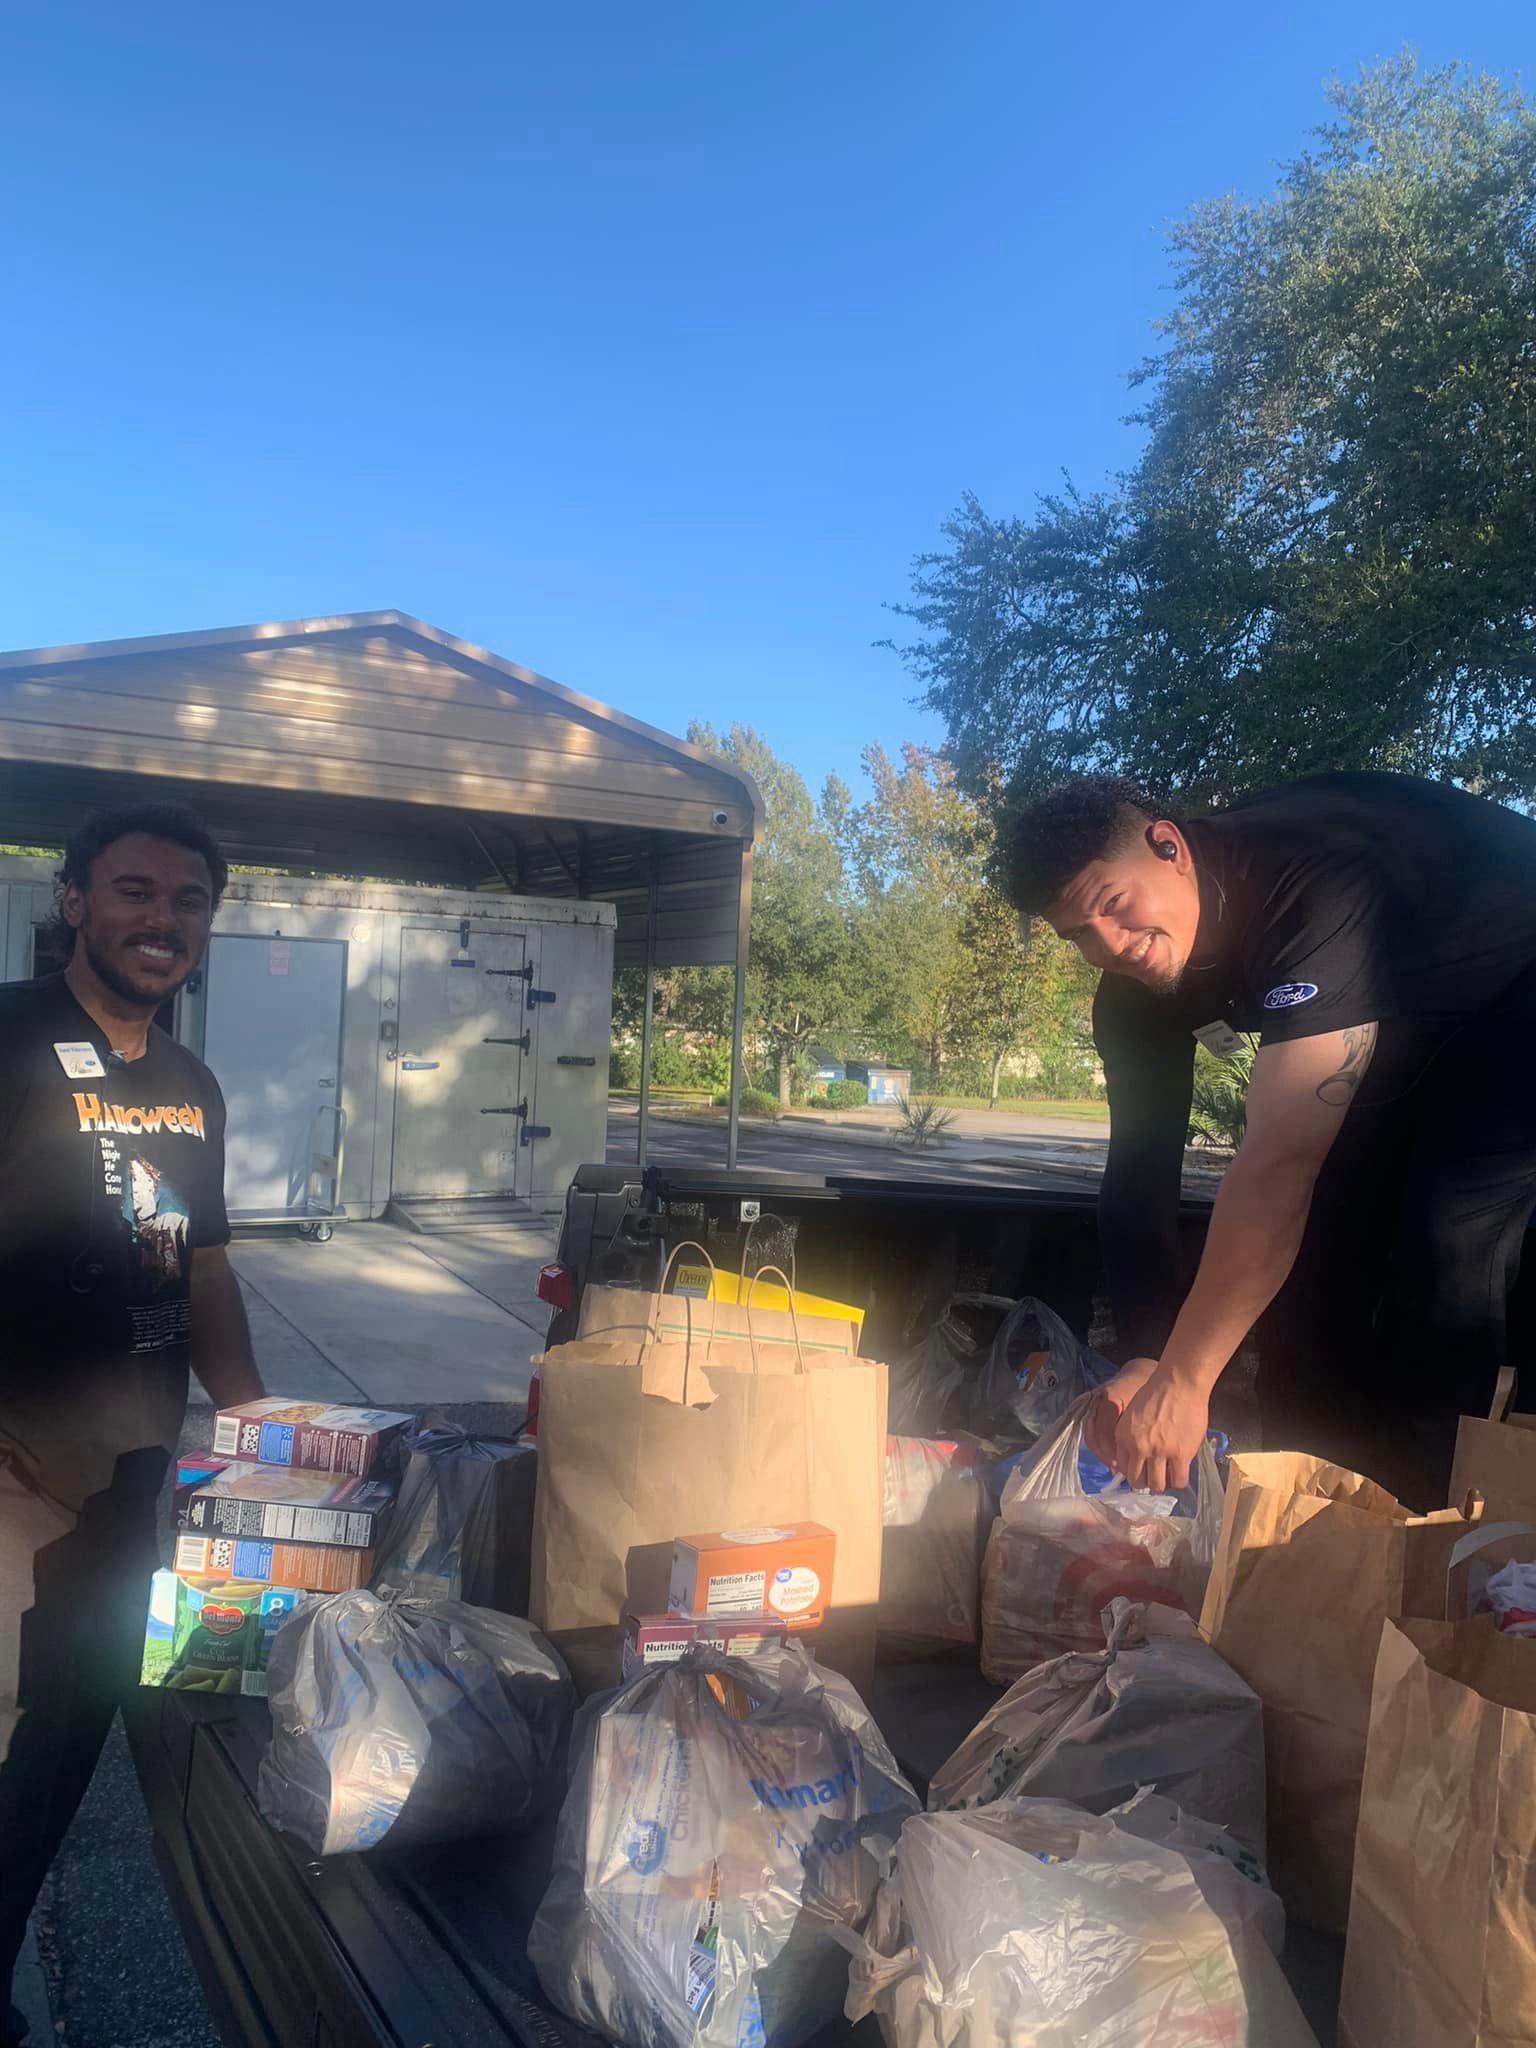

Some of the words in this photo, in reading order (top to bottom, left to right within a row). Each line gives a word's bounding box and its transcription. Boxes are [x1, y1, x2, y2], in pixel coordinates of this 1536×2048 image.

[1270, 987, 1305, 1006] Ford
[99, 1137, 115, 1149] The
[101, 1149, 121, 1162] Nigh
[104, 1161, 116, 1171] He
[104, 1172, 122, 1184] Cam
[105, 1184, 123, 1195] Hom
[710, 1576, 743, 1586] Nutrition
[744, 1573, 765, 1583] Facts
